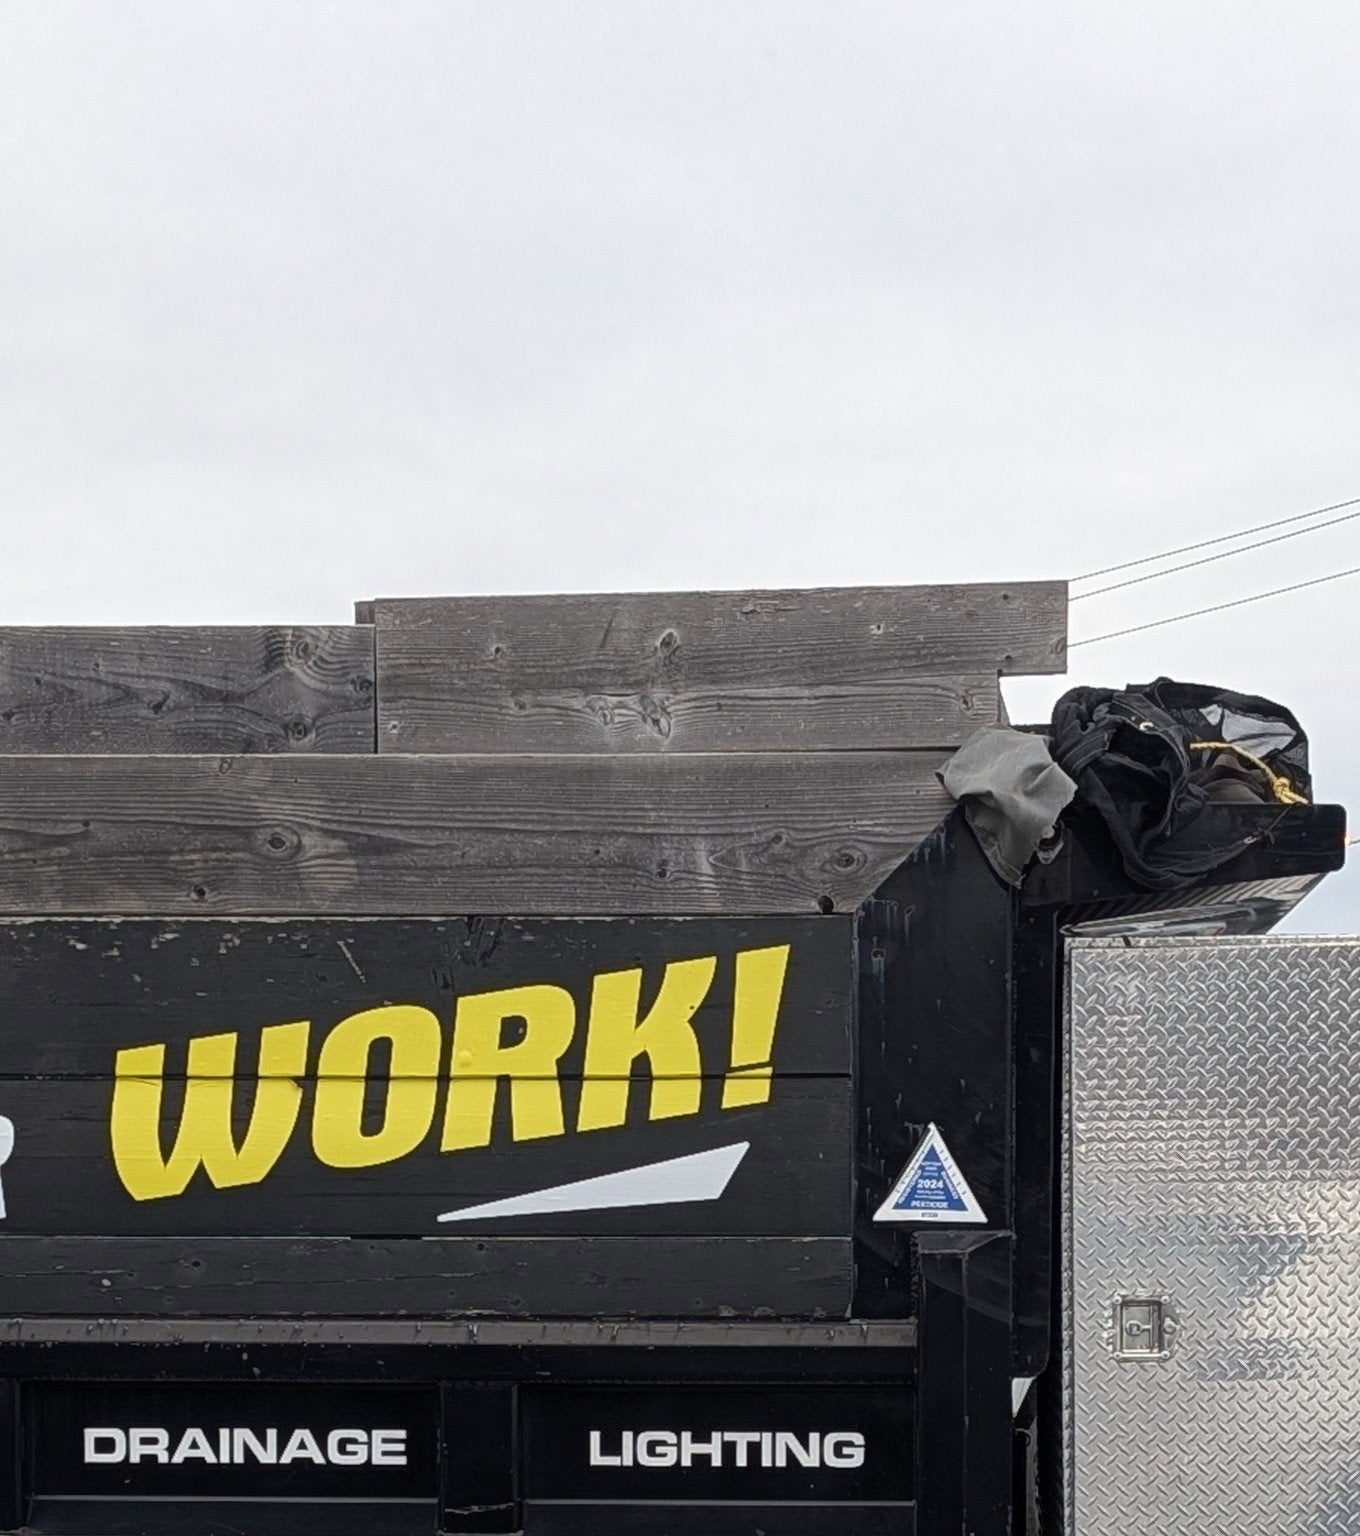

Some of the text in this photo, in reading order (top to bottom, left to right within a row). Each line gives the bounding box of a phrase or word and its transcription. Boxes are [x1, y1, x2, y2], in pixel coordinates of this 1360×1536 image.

[111, 944, 791, 1202] WORK!
[916, 1179, 945, 1189] 2024
[83, 1427, 408, 1466] DRAINAGE
[589, 1430, 866, 1469] LIGHTING
